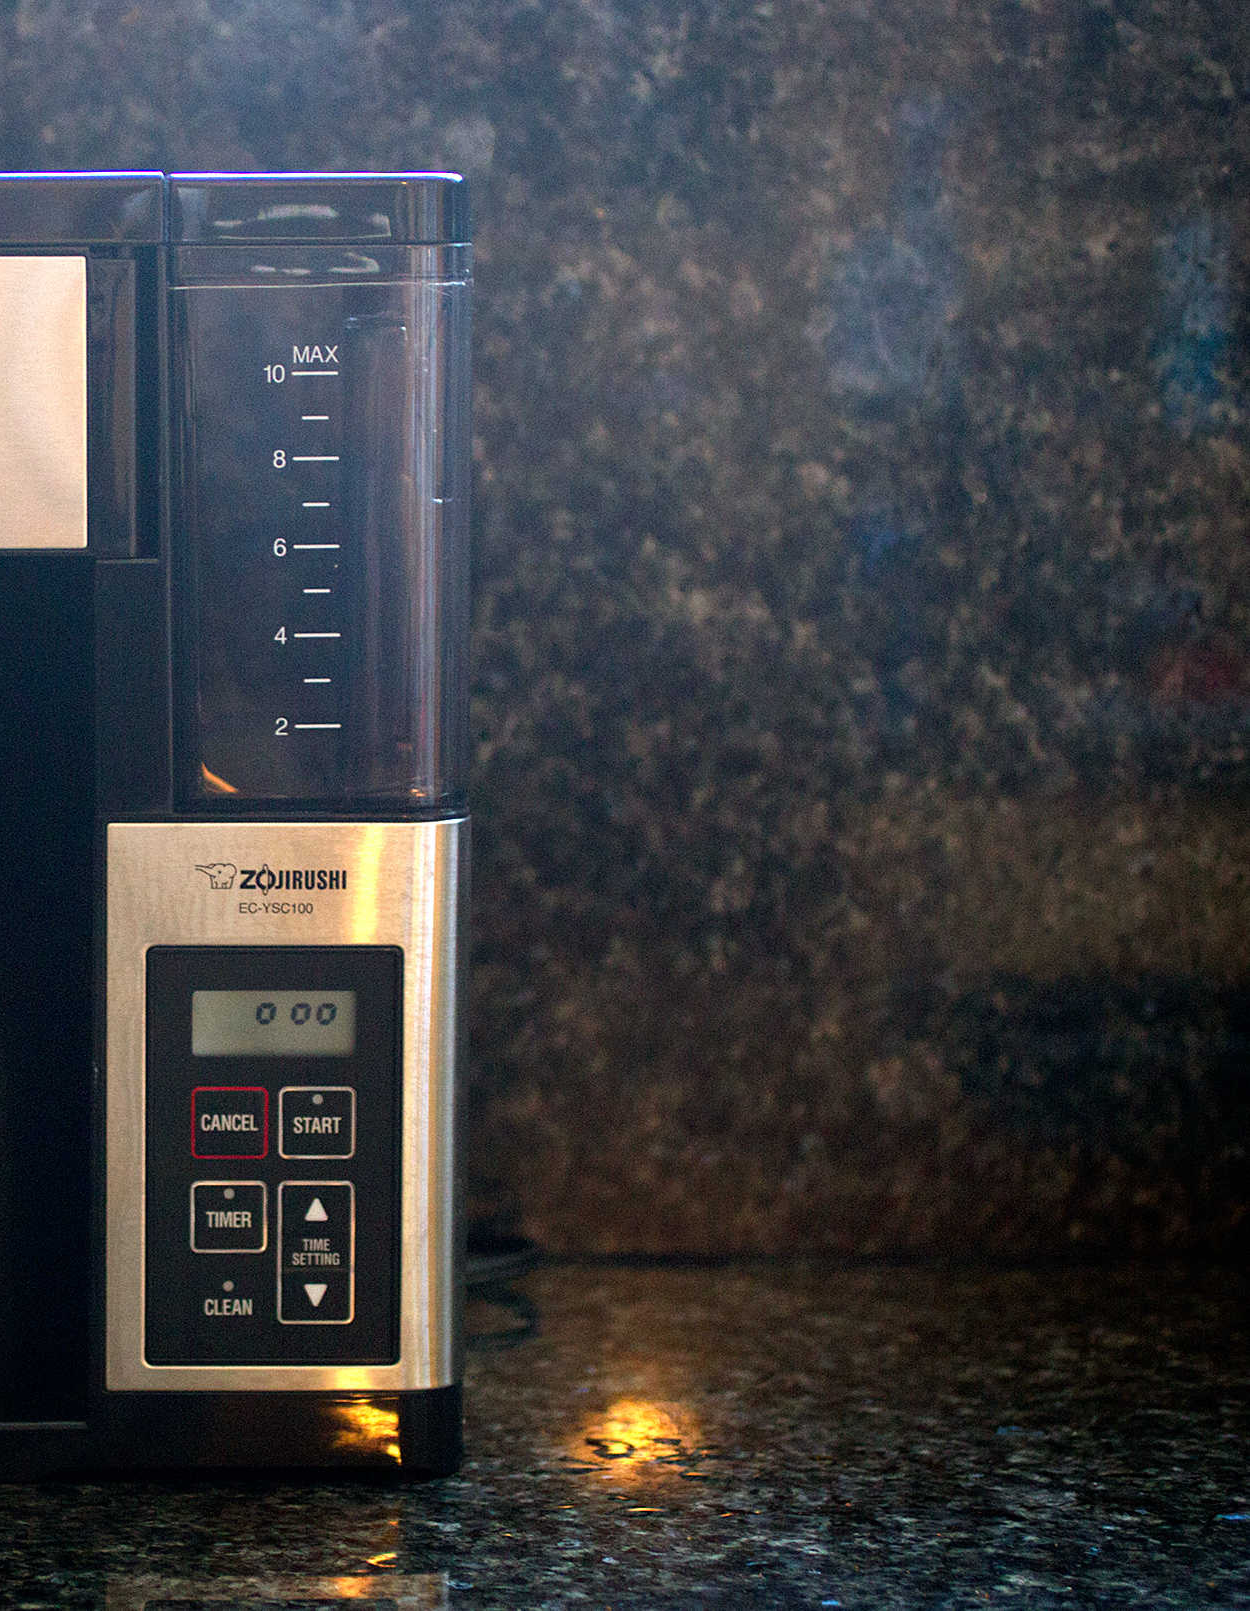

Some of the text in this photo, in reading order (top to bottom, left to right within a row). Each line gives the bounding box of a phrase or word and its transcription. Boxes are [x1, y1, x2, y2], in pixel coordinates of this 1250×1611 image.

[293, 345, 339, 364] MAX
[263, 364, 286, 384] 10
[272, 449, 287, 469] 8
[273, 537, 287, 557] 6
[274, 626, 287, 645] 4
[274, 717, 289, 736] 2
[238, 902, 314, 915] EC-YSC100
[201, 1114, 259, 1132] CANCEL
[293, 1116, 342, 1134] START
[206, 1211, 252, 1229] TIMER
[303, 1238, 331, 1251] TIME
[292, 1252, 340, 1266] SETTING
[204, 1299, 253, 1316] CLEAN
